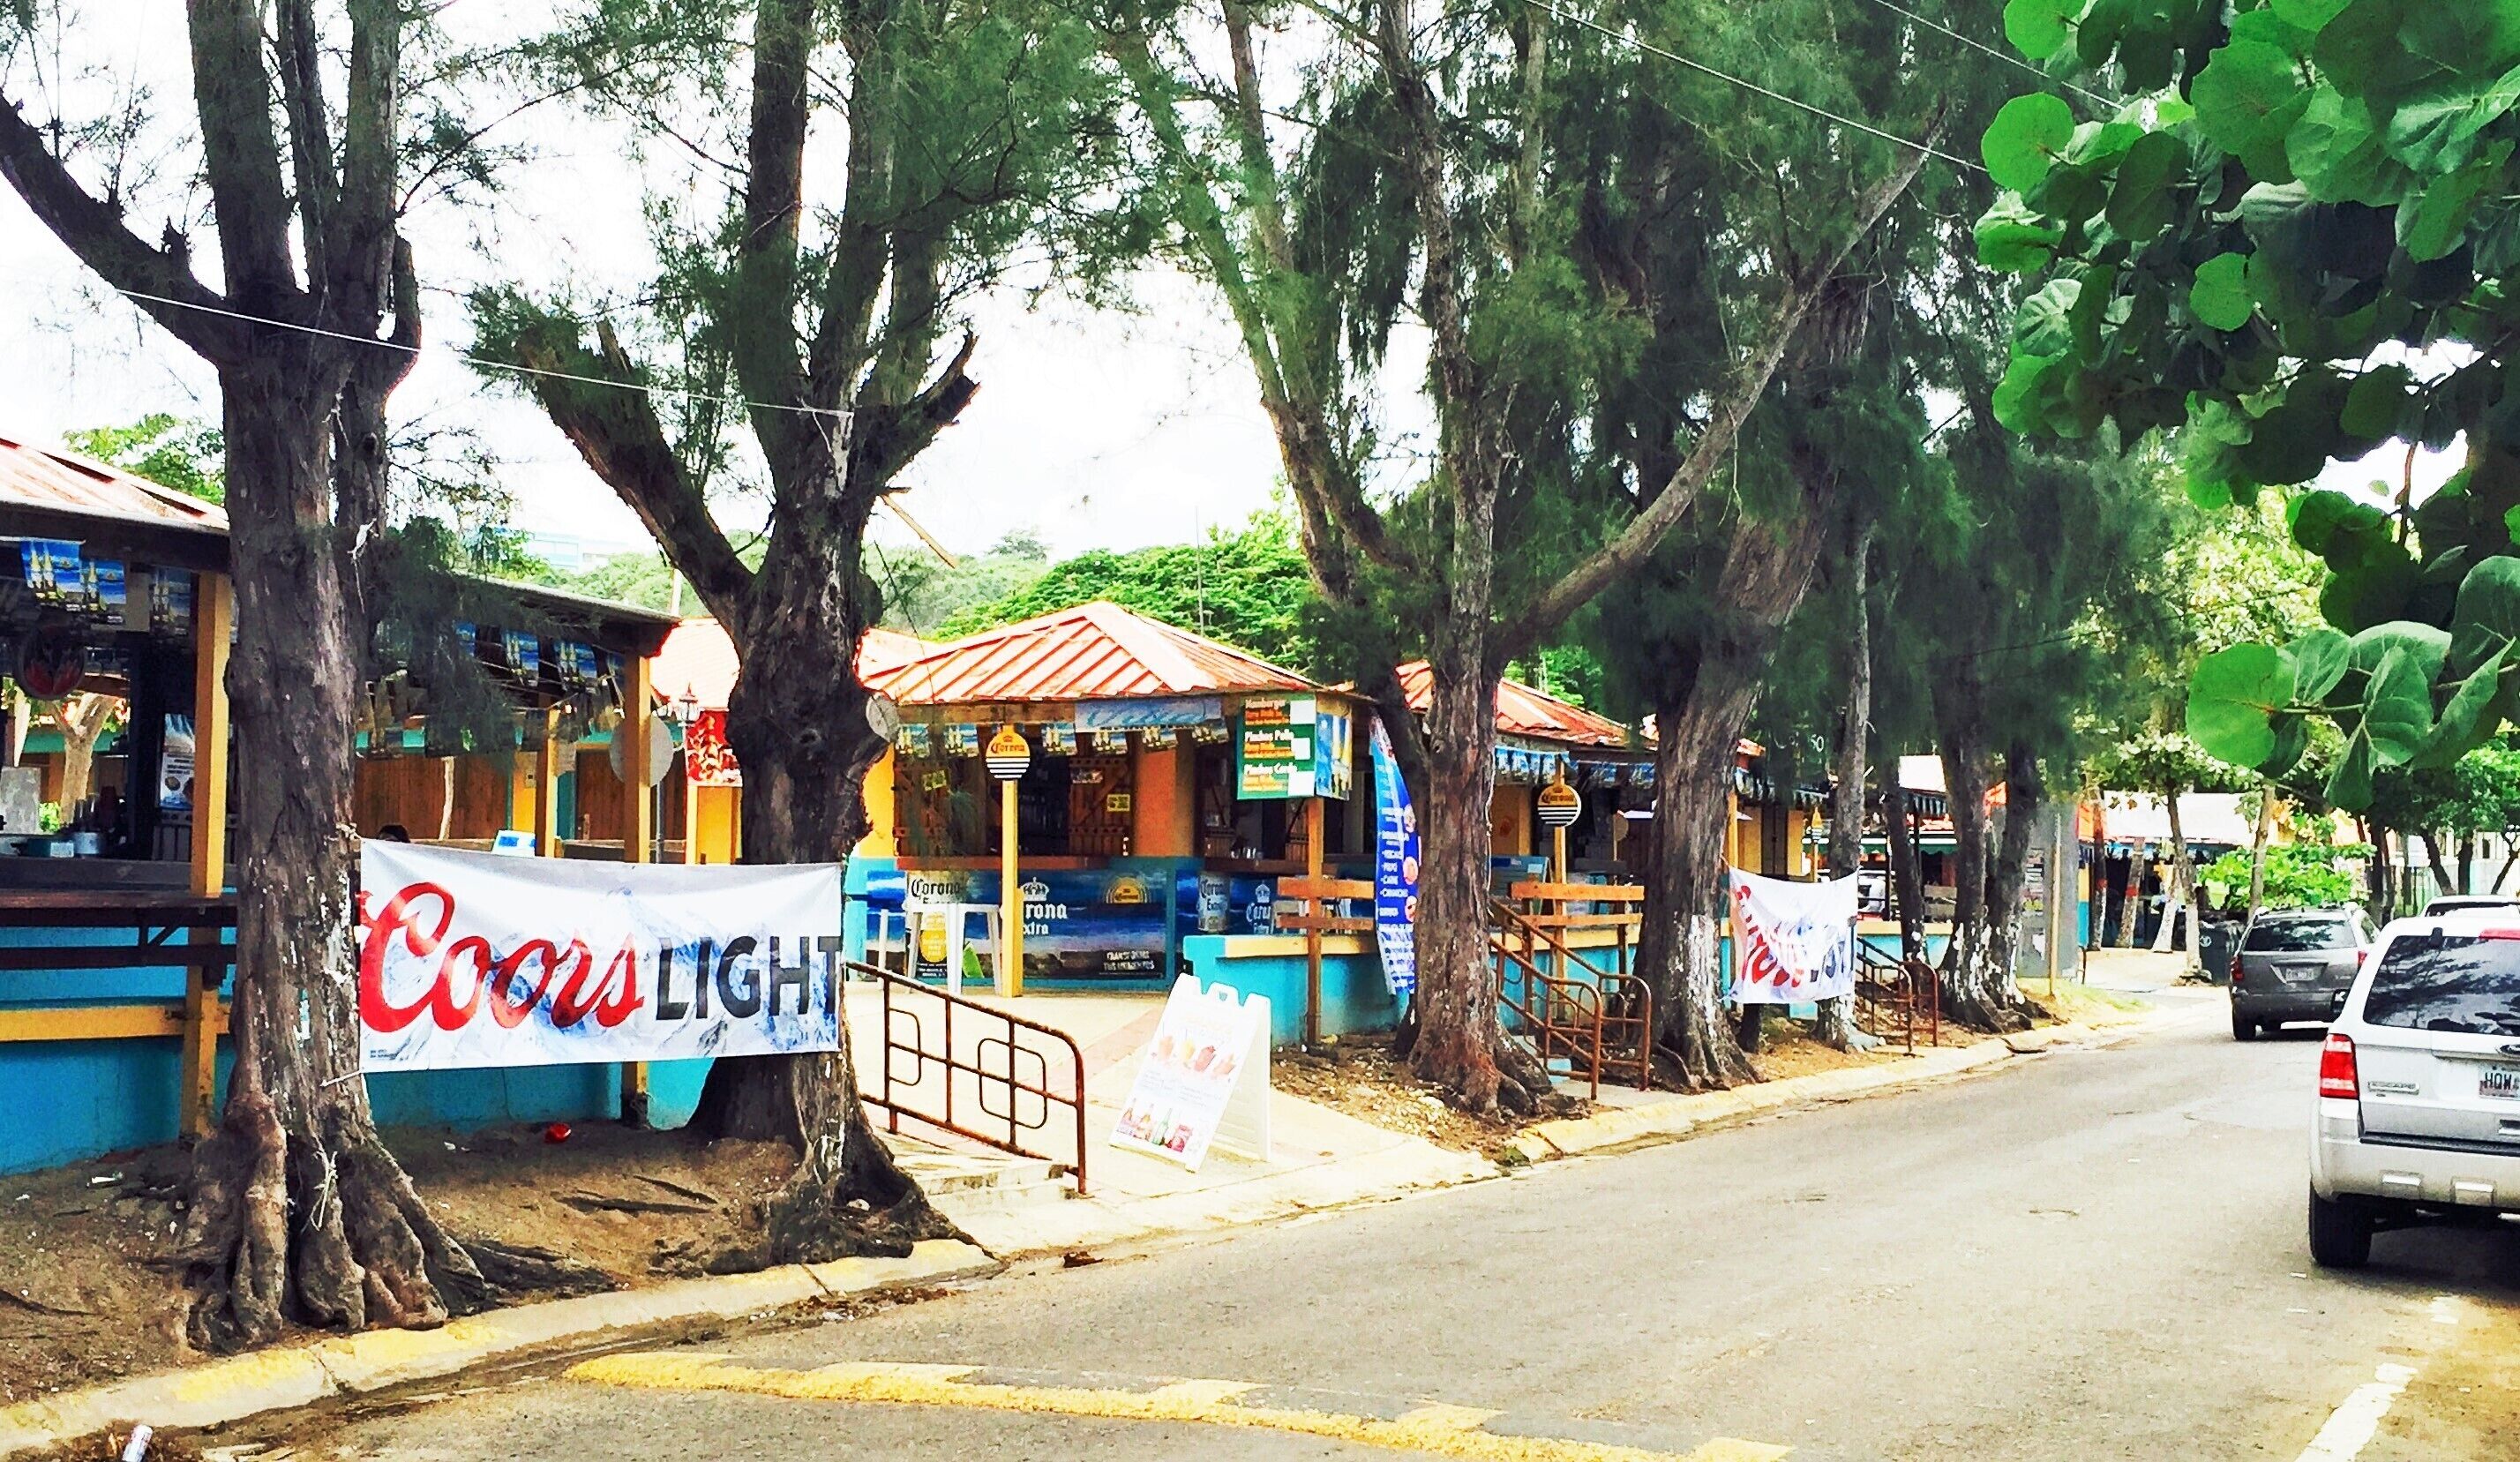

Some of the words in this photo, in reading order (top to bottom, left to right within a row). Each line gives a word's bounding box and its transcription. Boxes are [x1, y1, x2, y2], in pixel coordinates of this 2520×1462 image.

[991, 742, 1025, 754] Corona
[1541, 792, 1574, 804] Corona
[1024, 903, 1069, 920] rona
[1022, 920, 1049, 936] xtra
[358, 882, 644, 1033] Coors
[655, 934, 843, 1022] LIGHT
